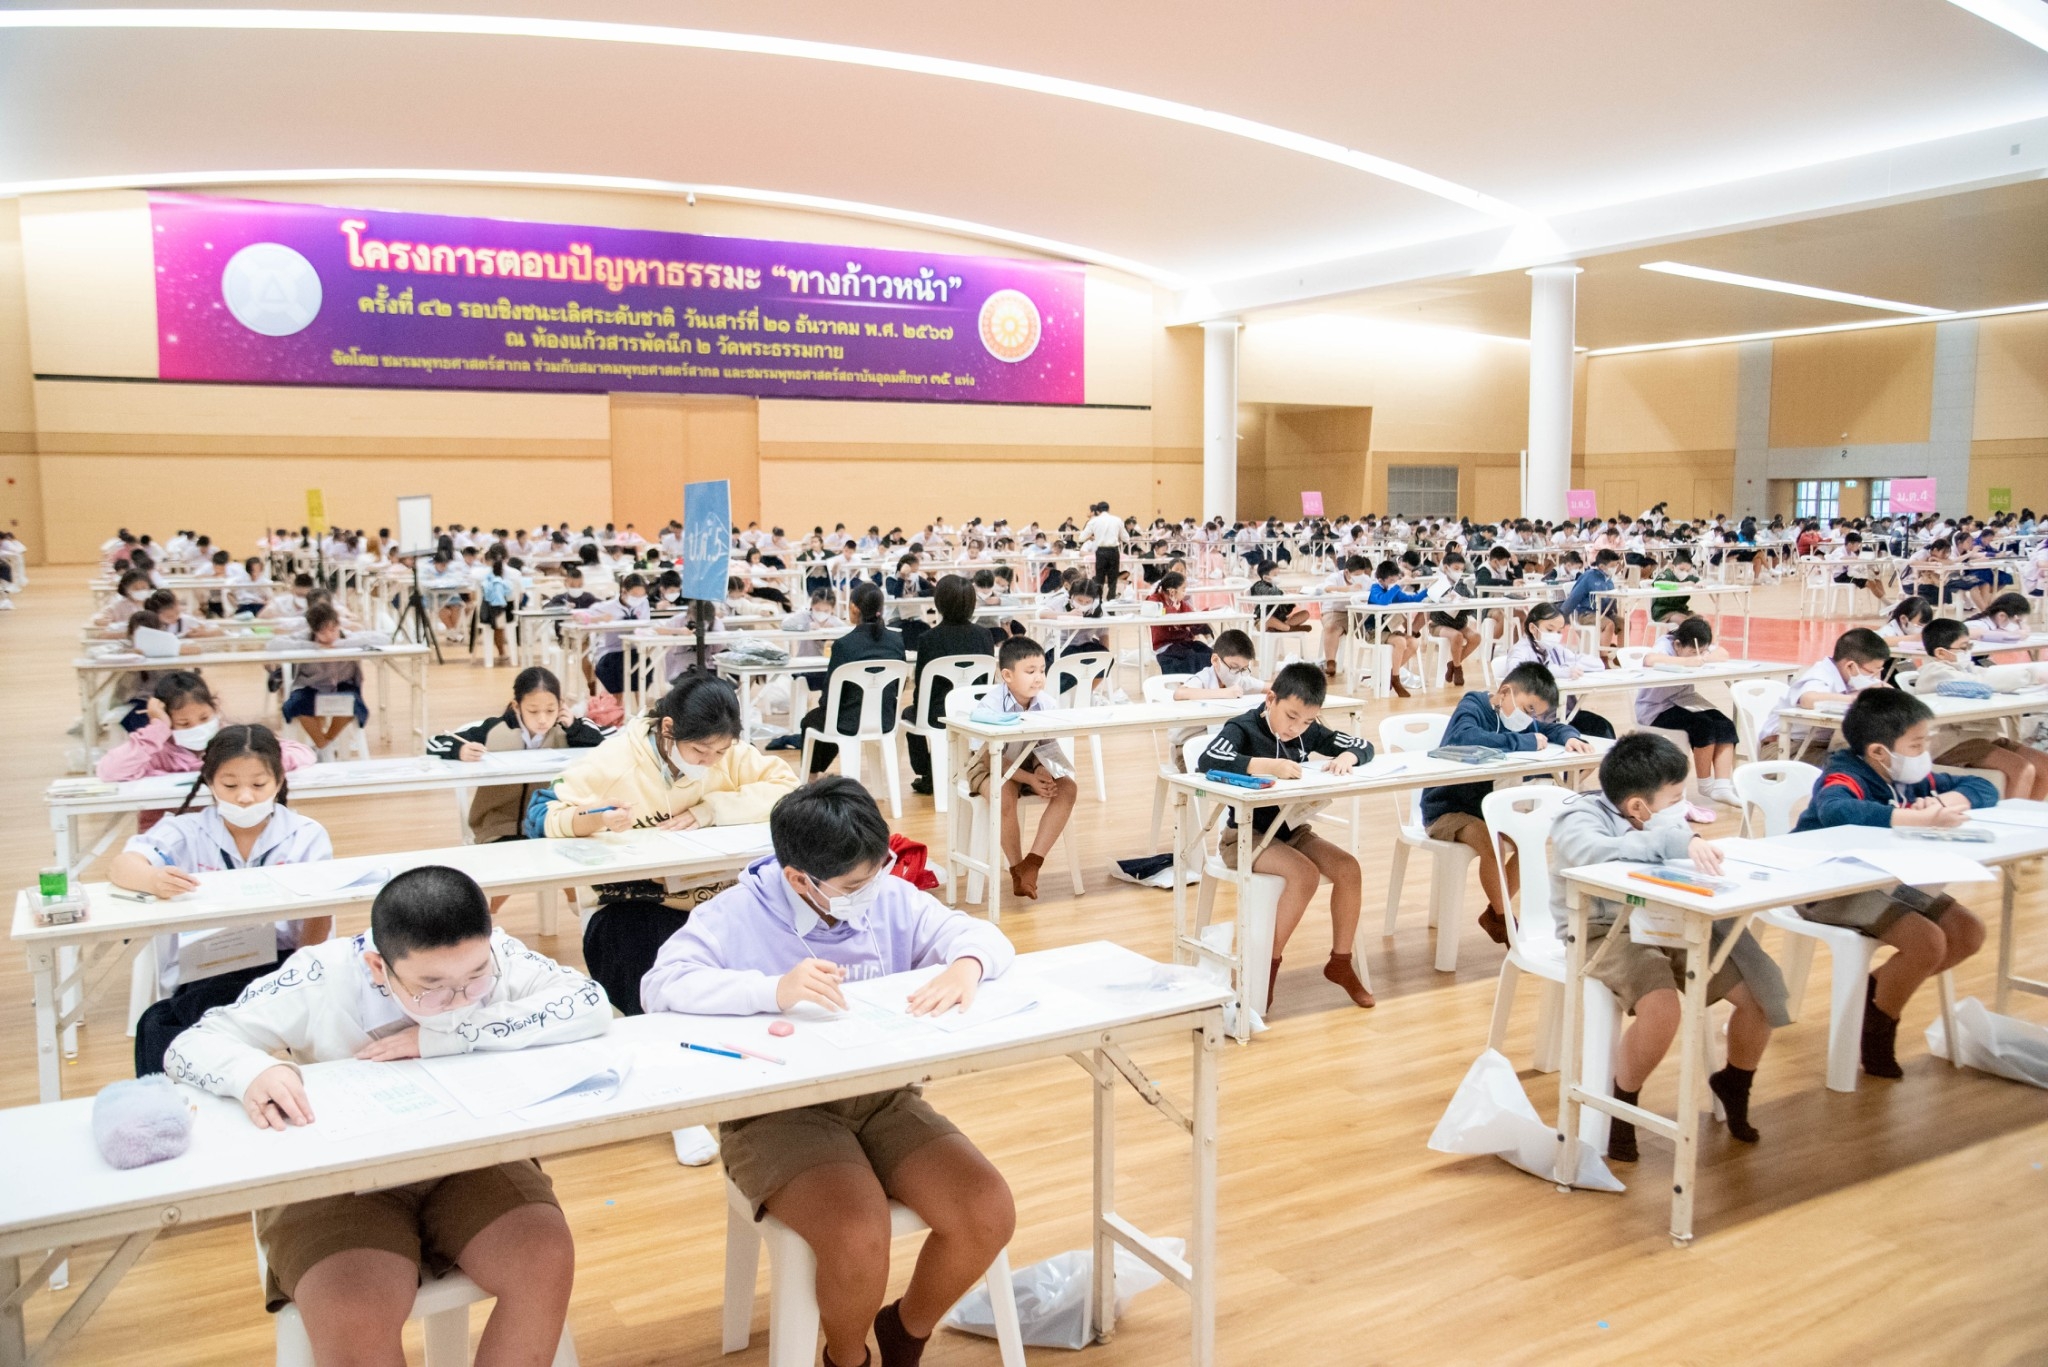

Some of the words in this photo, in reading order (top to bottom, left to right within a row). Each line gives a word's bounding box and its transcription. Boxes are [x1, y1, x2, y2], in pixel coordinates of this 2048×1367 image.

[340, 218, 762, 292] โครงการตอบปัญหาธรรมะ
[771, 261, 962, 303] “ทางก้าวหน้า”
[358, 283, 414, 315] ครั้งที่
[418, 298, 452, 317] ๔๒
[458, 297, 675, 327] รอบชิงชนะเลิศระดับชาติ
[684, 306, 759, 331] วันเสาร์ที่
[763, 316, 790, 334] ๒๑
[795, 313, 860, 336] ธันวาคม
[864, 323, 899, 338] พ.ศ.
[903, 323, 954, 340] ๒๕๖๗
[331, 346, 379, 367] จัดโดย
[381, 354, 530, 374] ชมรมพุทธศาสตร์สากล
[505, 331, 527, 348] ณ
[531, 326, 692, 354] ห้องแก้วสารพัดนึก
[696, 338, 711, 355] ๒
[716, 335, 844, 360] วัดพระธรรมกาย
[1841, 449, 1848, 458] 2
